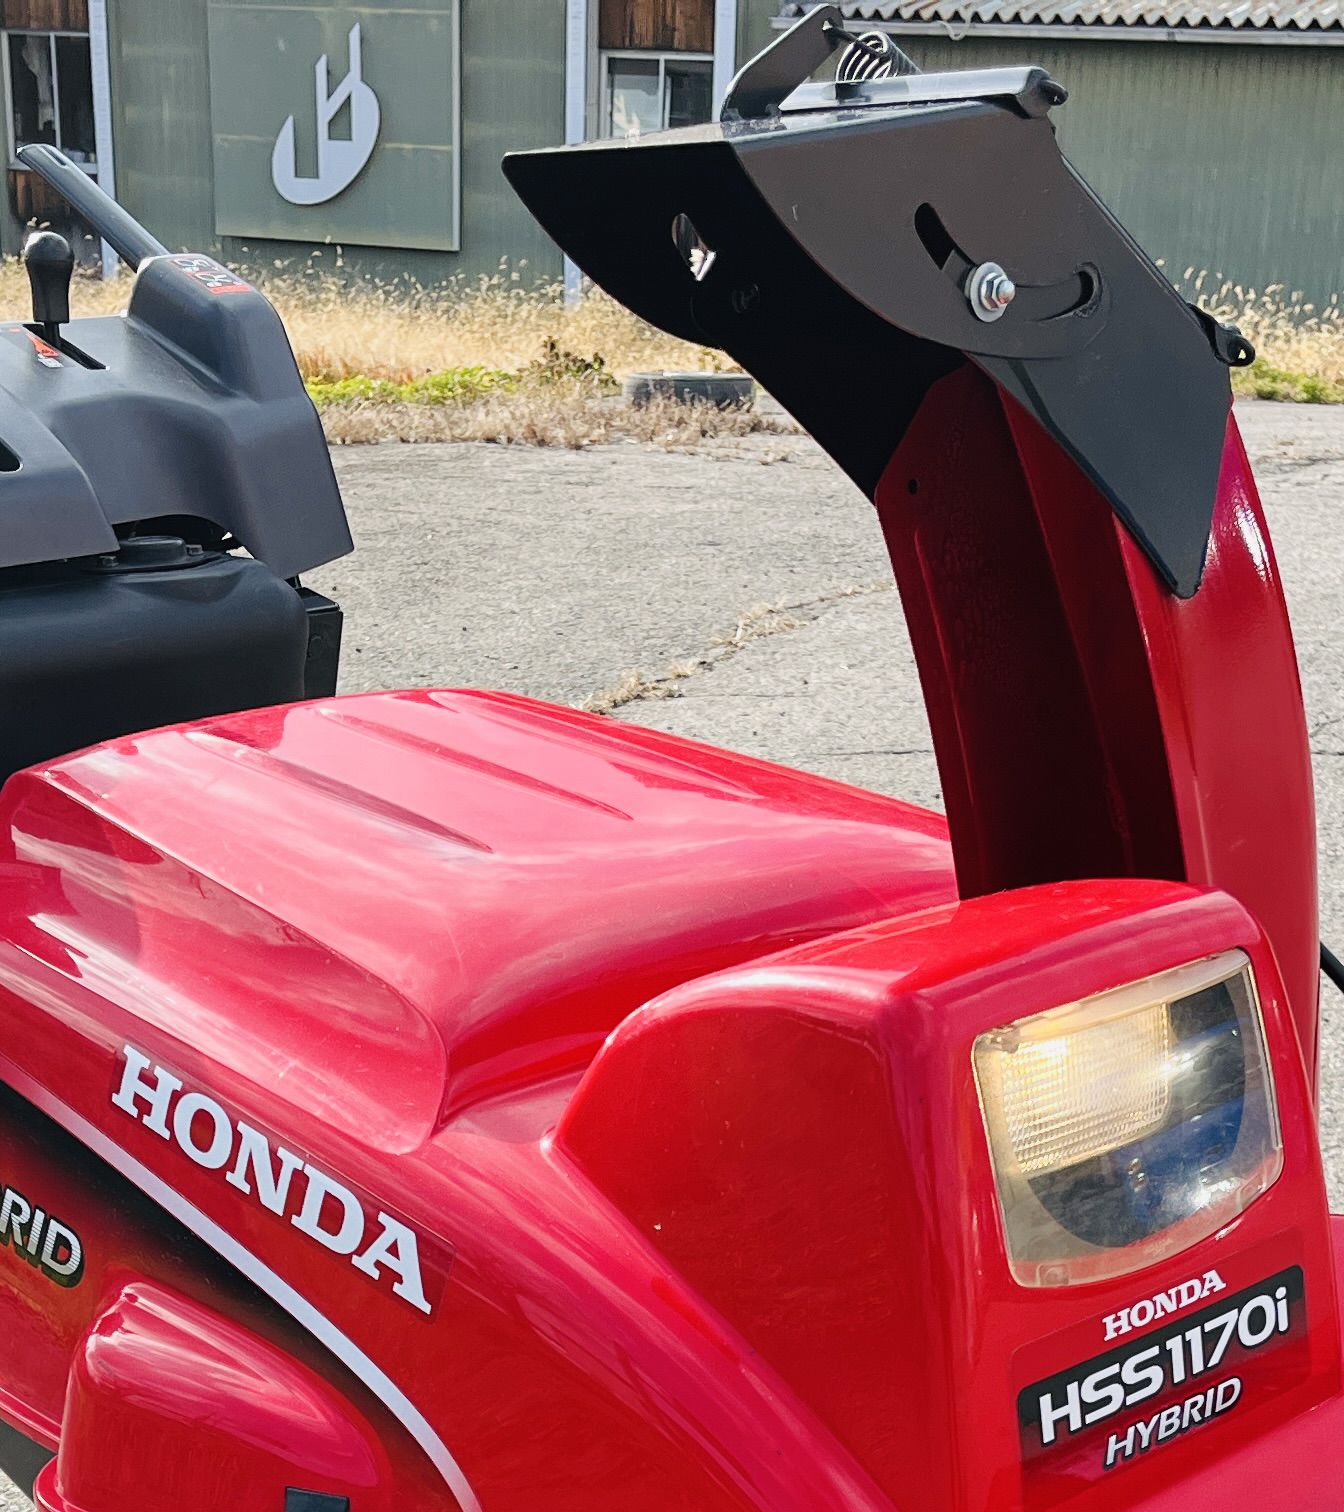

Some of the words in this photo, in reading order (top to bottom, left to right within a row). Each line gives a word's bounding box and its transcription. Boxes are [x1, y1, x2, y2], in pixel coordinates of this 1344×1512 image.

[111, 1044, 432, 1315] HONDA
[1038, 1286, 1289, 1445] HSS1170i
[1102, 1270, 1227, 1342] HONDA
[1104, 1377, 1242, 1467] HYBRID
